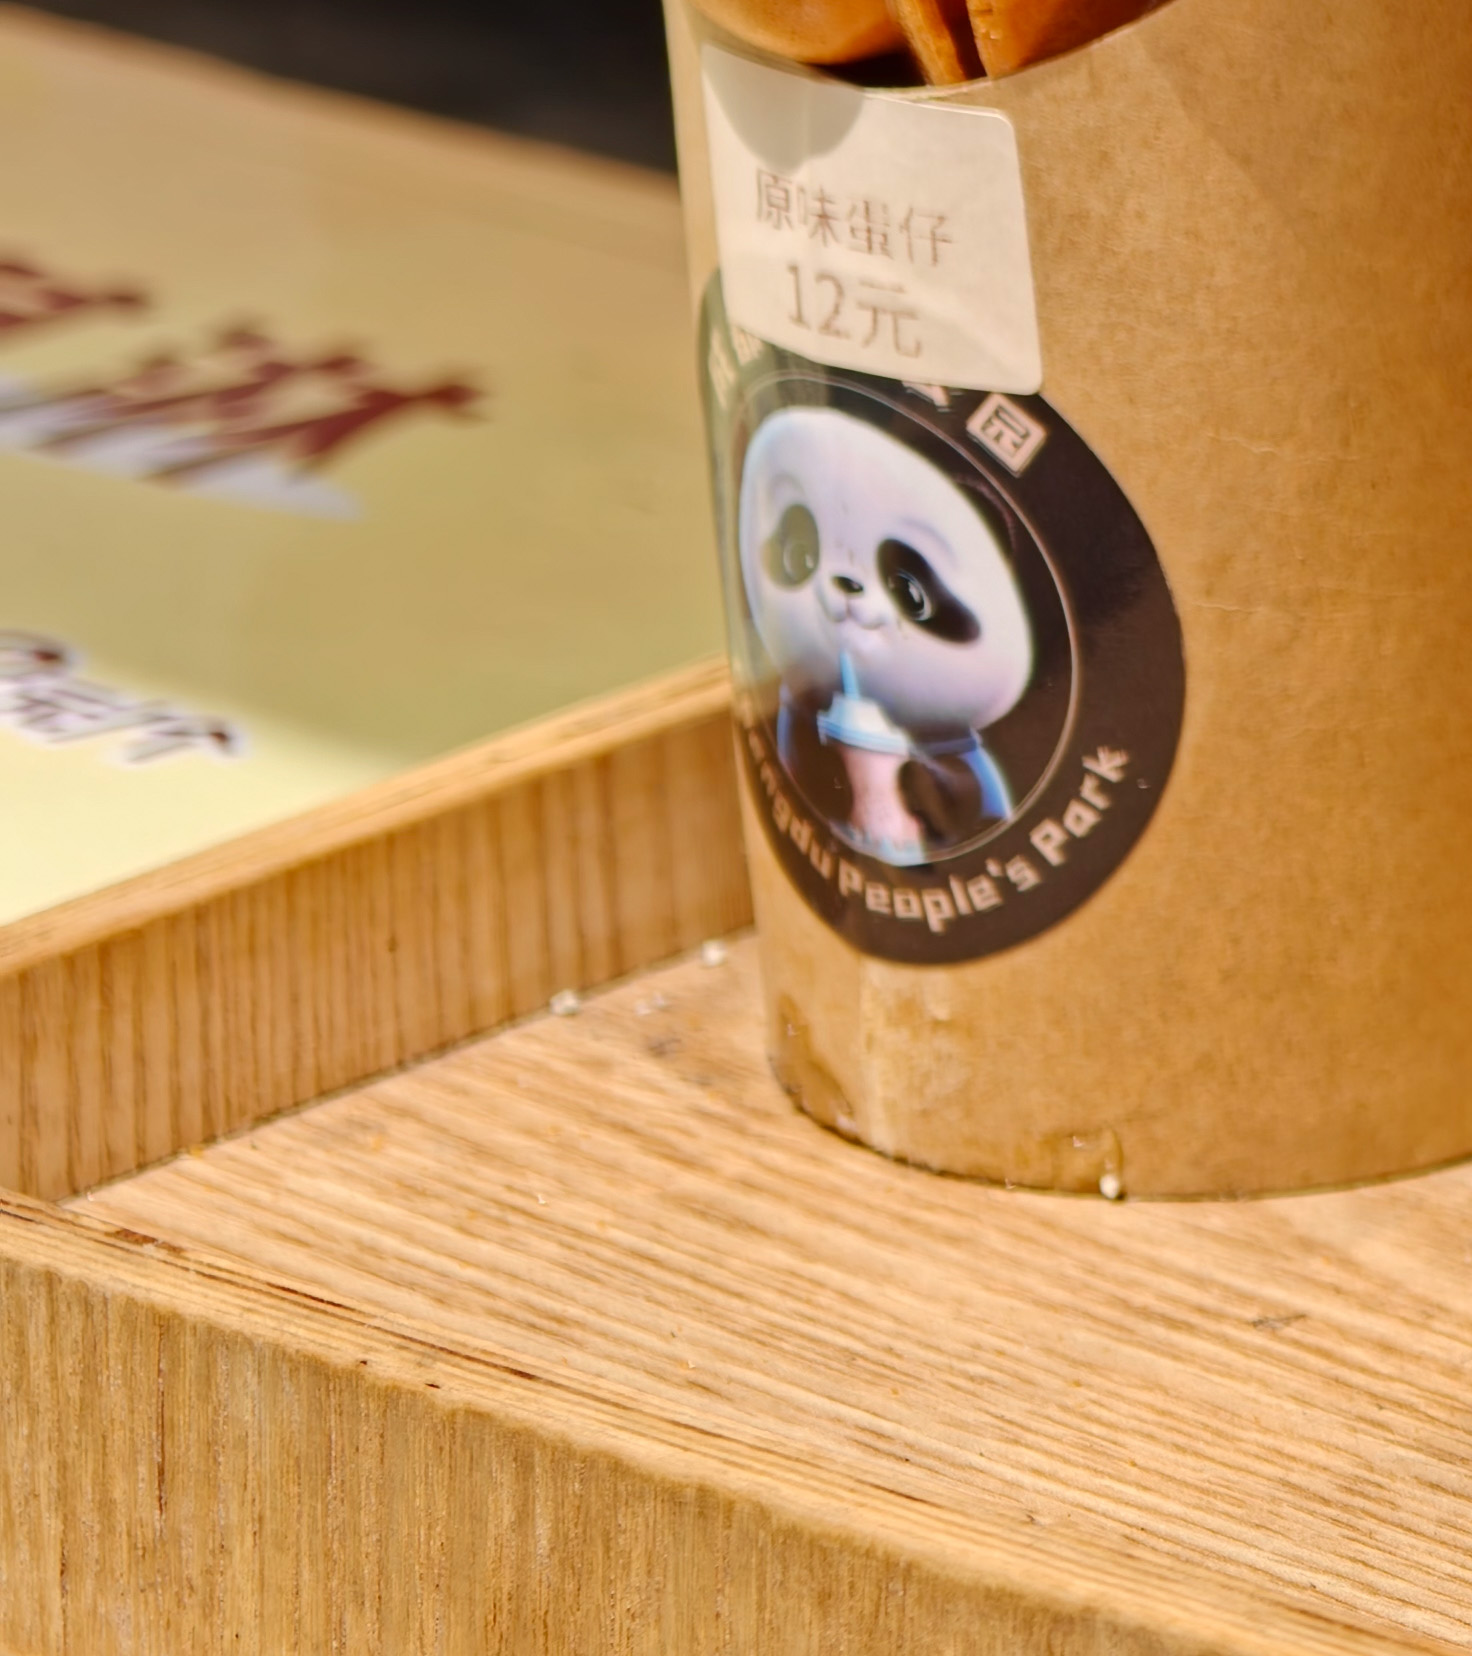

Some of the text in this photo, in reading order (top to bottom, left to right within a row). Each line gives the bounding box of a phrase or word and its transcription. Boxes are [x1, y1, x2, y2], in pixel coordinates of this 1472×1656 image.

[754, 166, 955, 267] 原味蛋仔
[786, 261, 922, 359] 12元
[838, 855, 1043, 935] People's
[1029, 744, 1131, 867] Park
